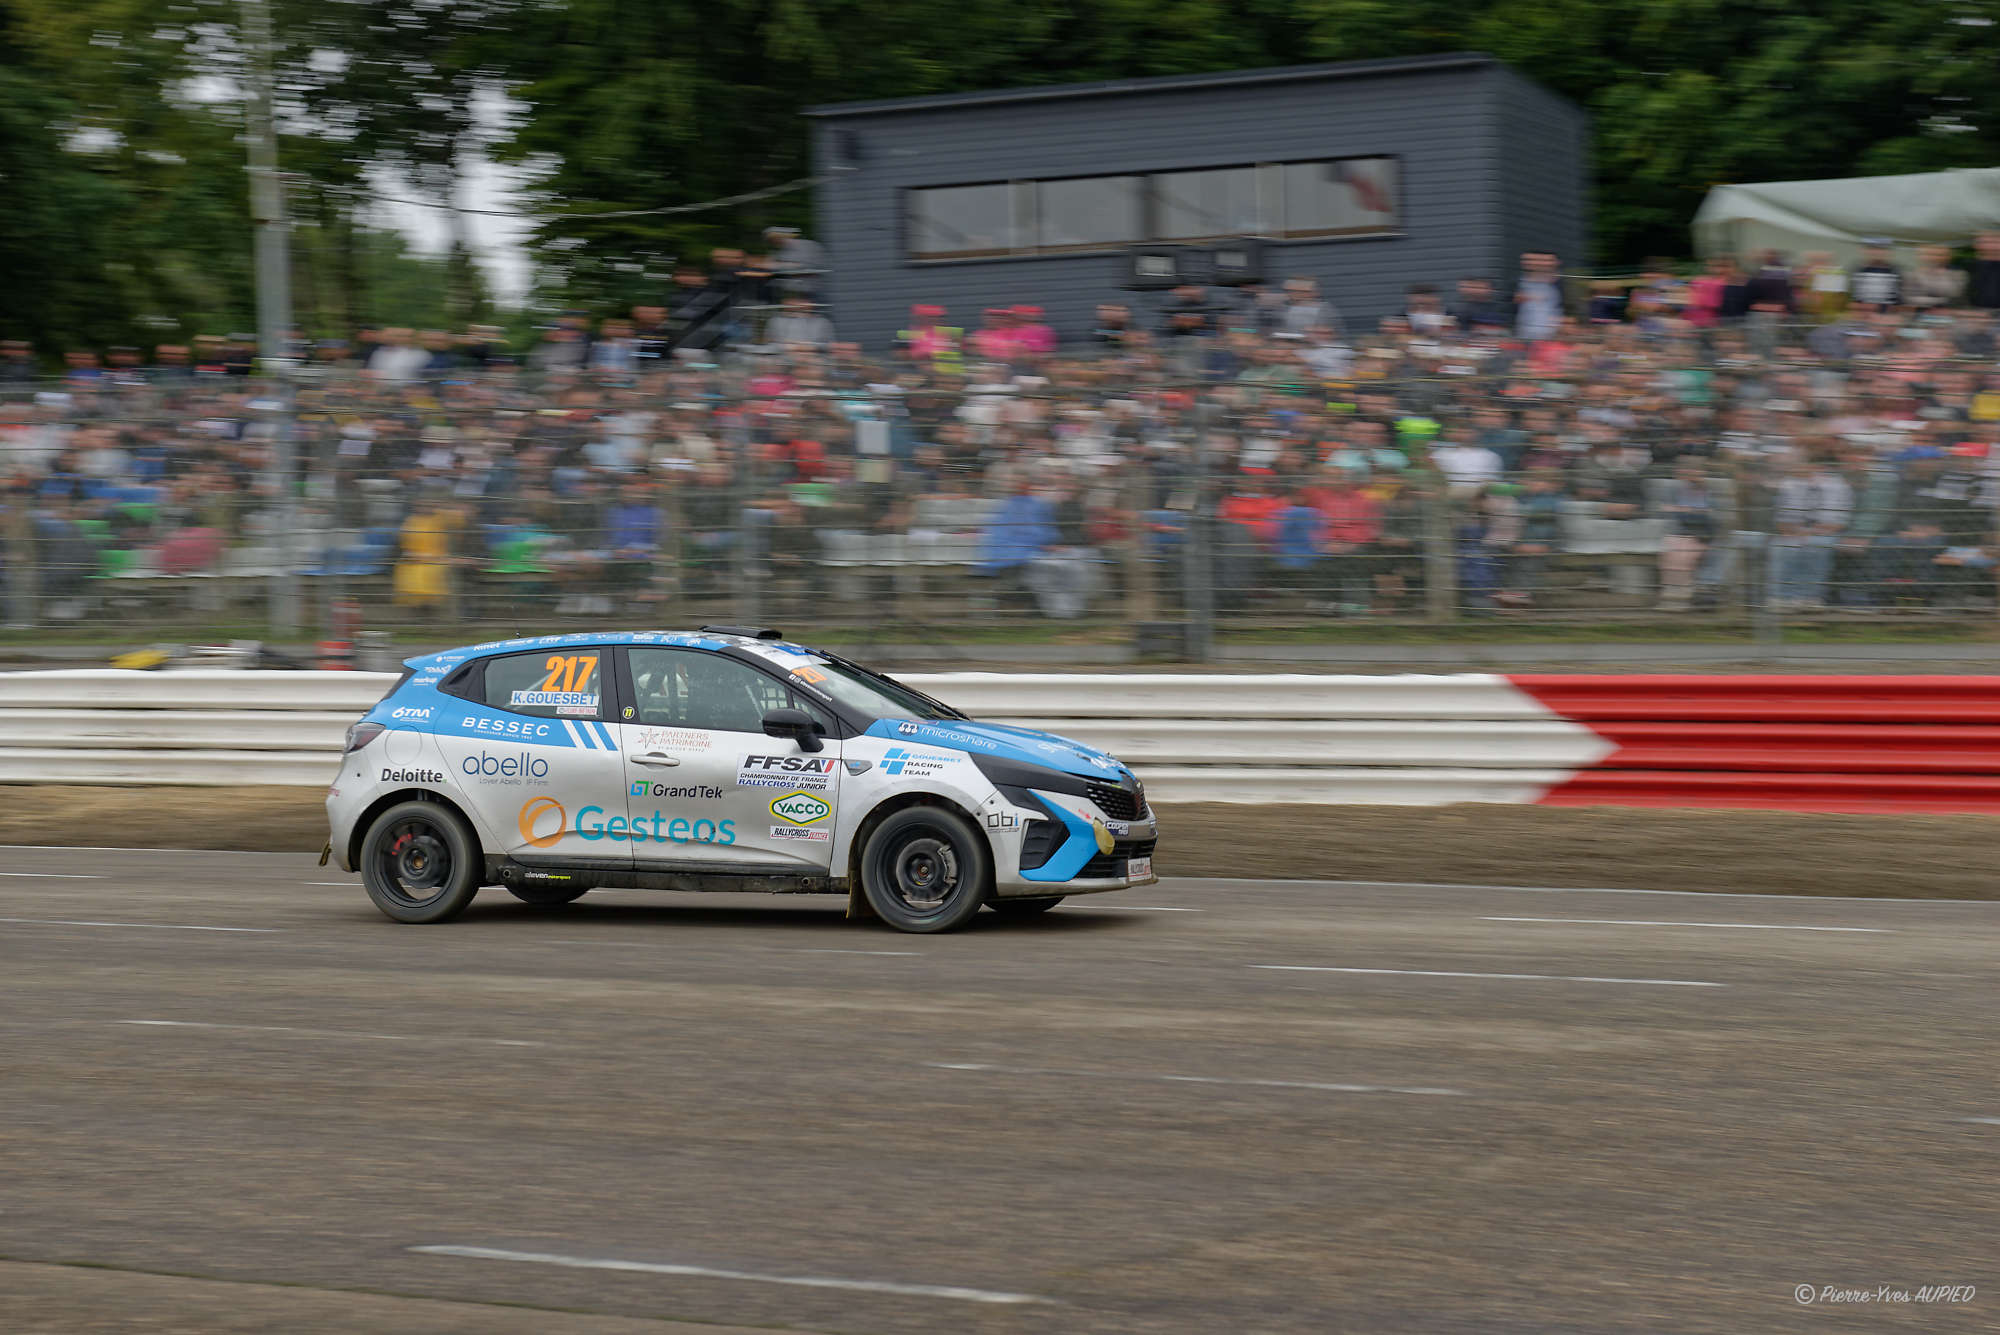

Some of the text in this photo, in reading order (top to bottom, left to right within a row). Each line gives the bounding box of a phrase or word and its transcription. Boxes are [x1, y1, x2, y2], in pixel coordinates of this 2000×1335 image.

[542, 655, 598, 692] 217
[513, 692, 597, 705] K.GOUESBET
[461, 716, 550, 737] BESSEC
[661, 730, 710, 740] PARTNERS
[921, 727, 998, 750] microshare
[659, 738, 713, 748] PATRIMOINE
[462, 750, 549, 777] abello
[743, 754, 823, 773] FFSA
[907, 761, 944, 769] RACING
[740, 772, 789, 782] CHAMPIONNAT
[801, 776, 829, 784] FRANCE
[903, 769, 931, 777] TEAM
[738, 778, 827, 791] RALLYCROSS JUNIOR
[778, 803, 825, 815] YACCO
[575, 805, 737, 845] Gesteos
[773, 827, 810, 838] RALLYCROSS
